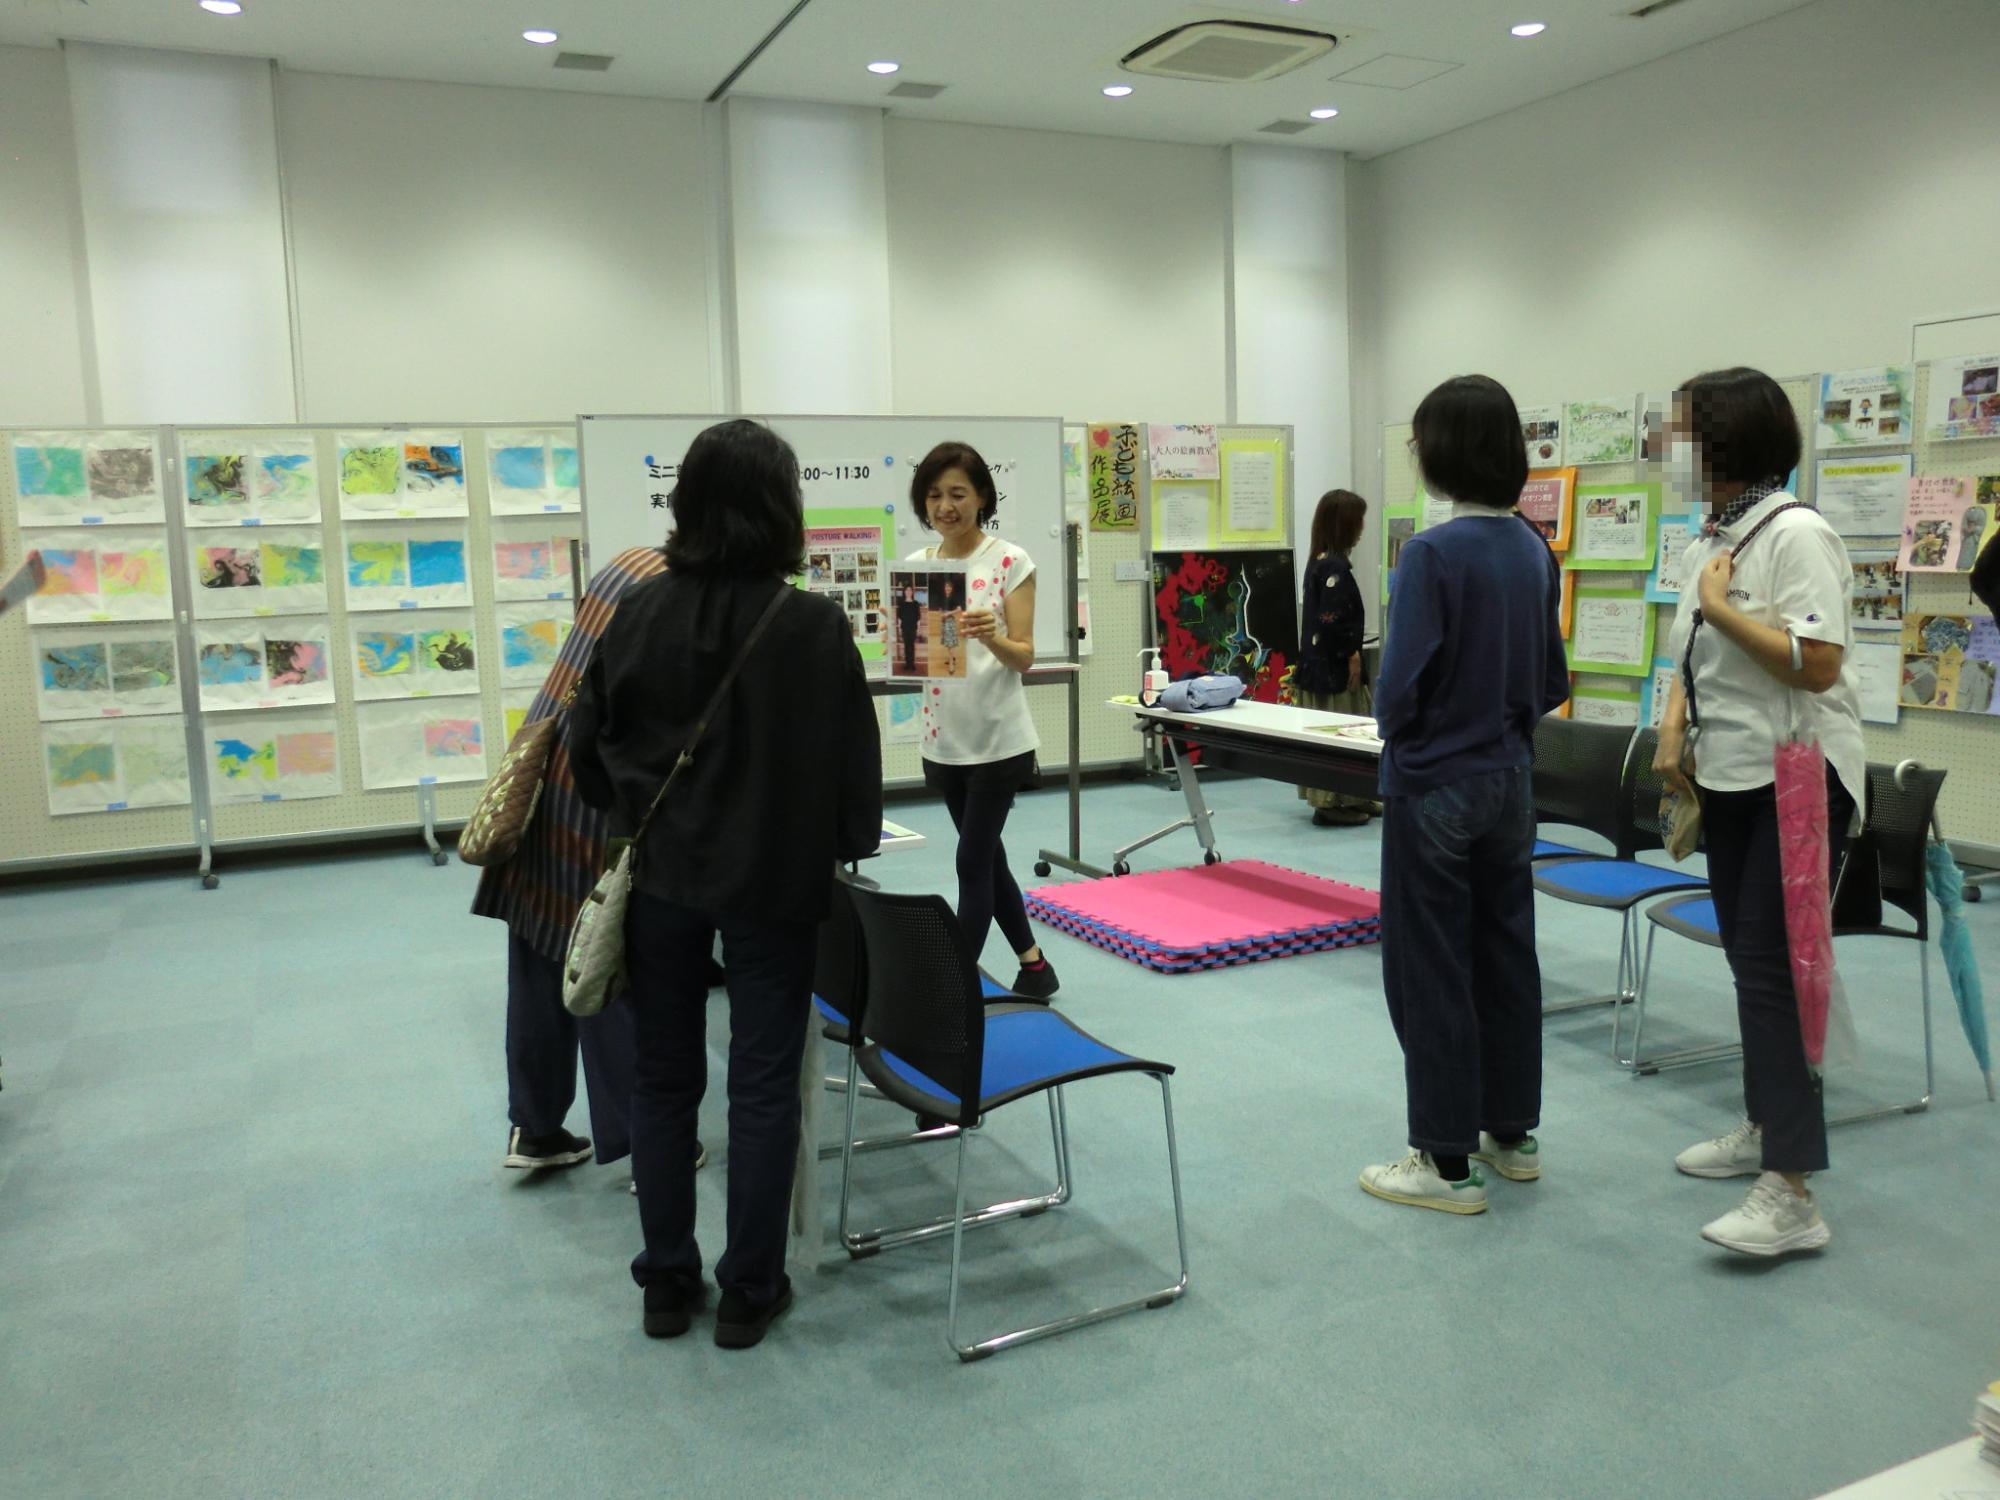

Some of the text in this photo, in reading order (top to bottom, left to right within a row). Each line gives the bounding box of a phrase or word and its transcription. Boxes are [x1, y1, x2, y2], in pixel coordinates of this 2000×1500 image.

[1111, 425, 1138, 522] 子ども絵画
